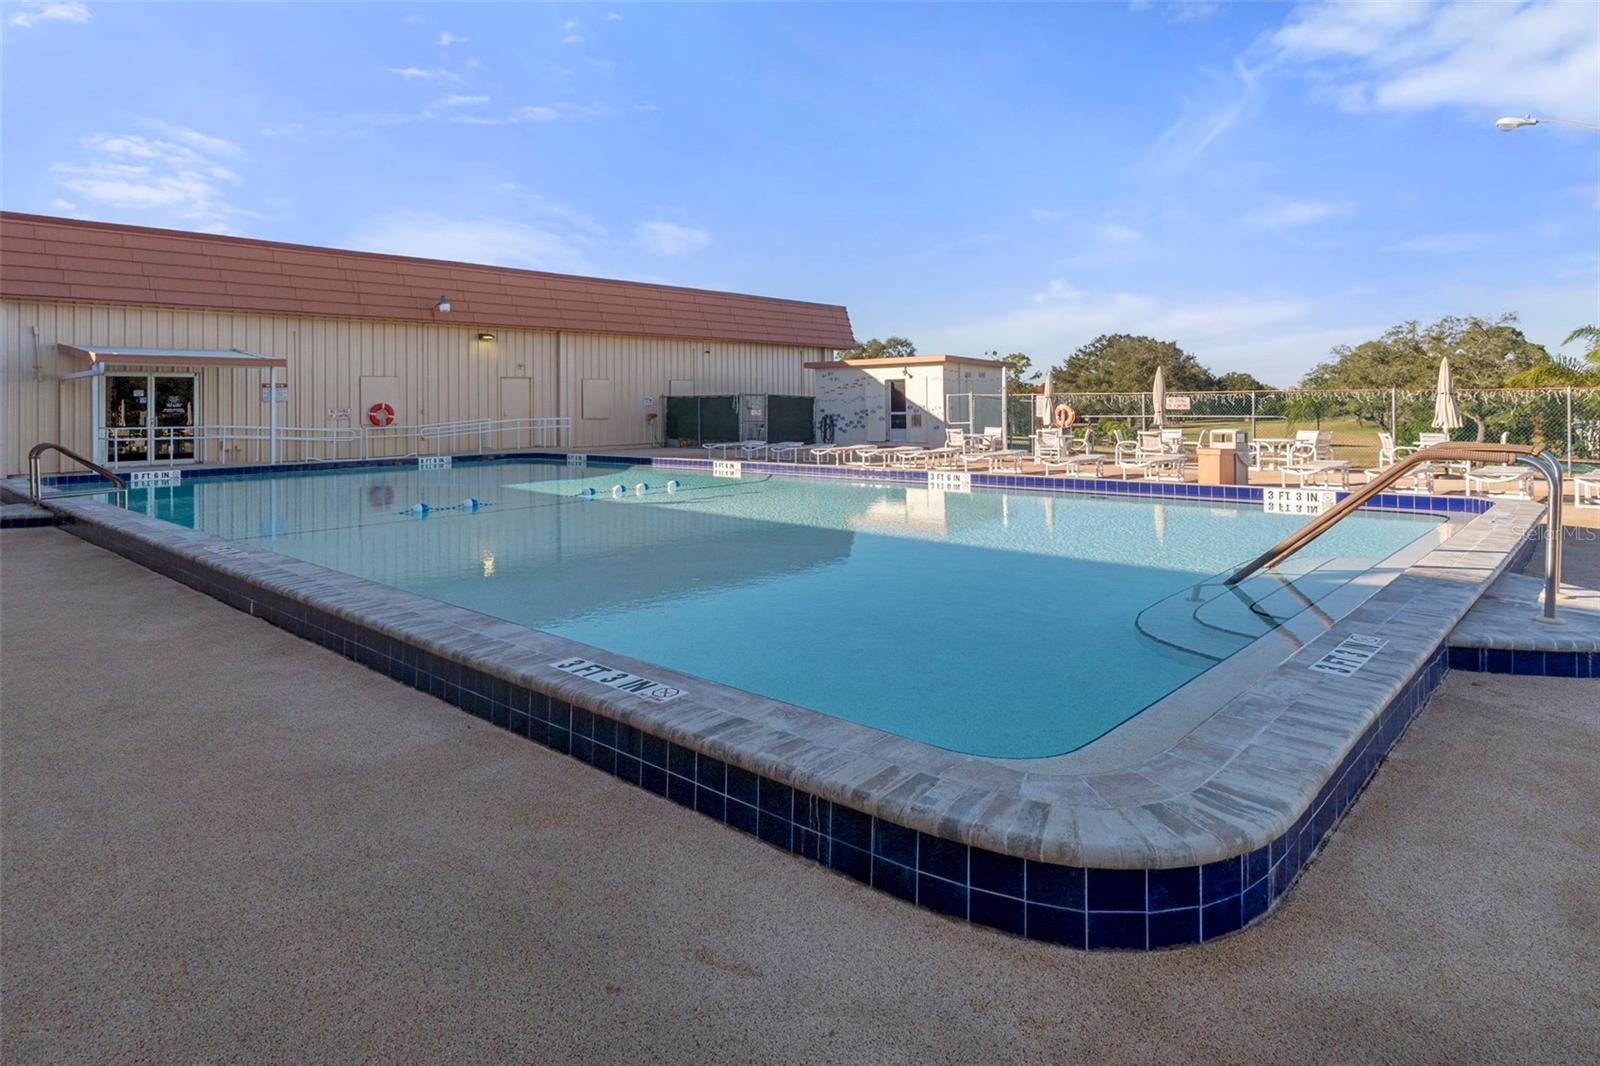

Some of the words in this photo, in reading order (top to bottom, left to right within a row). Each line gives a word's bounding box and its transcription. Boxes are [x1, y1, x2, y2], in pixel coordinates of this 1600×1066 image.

[141, 472, 151, 480] FT
[161, 471, 170, 479] IN
[936, 473, 944, 481] FT
[953, 474, 960, 482] IN
[1267, 490, 1274, 500] 3
[1278, 491, 1290, 501] FT
[1295, 491, 1302, 502] 3
[1334, 649, 1370, 658] 3
[1320, 654, 1363, 669] FT
[1314, 664, 1352, 674] 3
[557, 659, 585, 669] 3
[571, 664, 613, 677] FT
[599, 673, 629, 683] 3
[617, 678, 659, 693] IN
